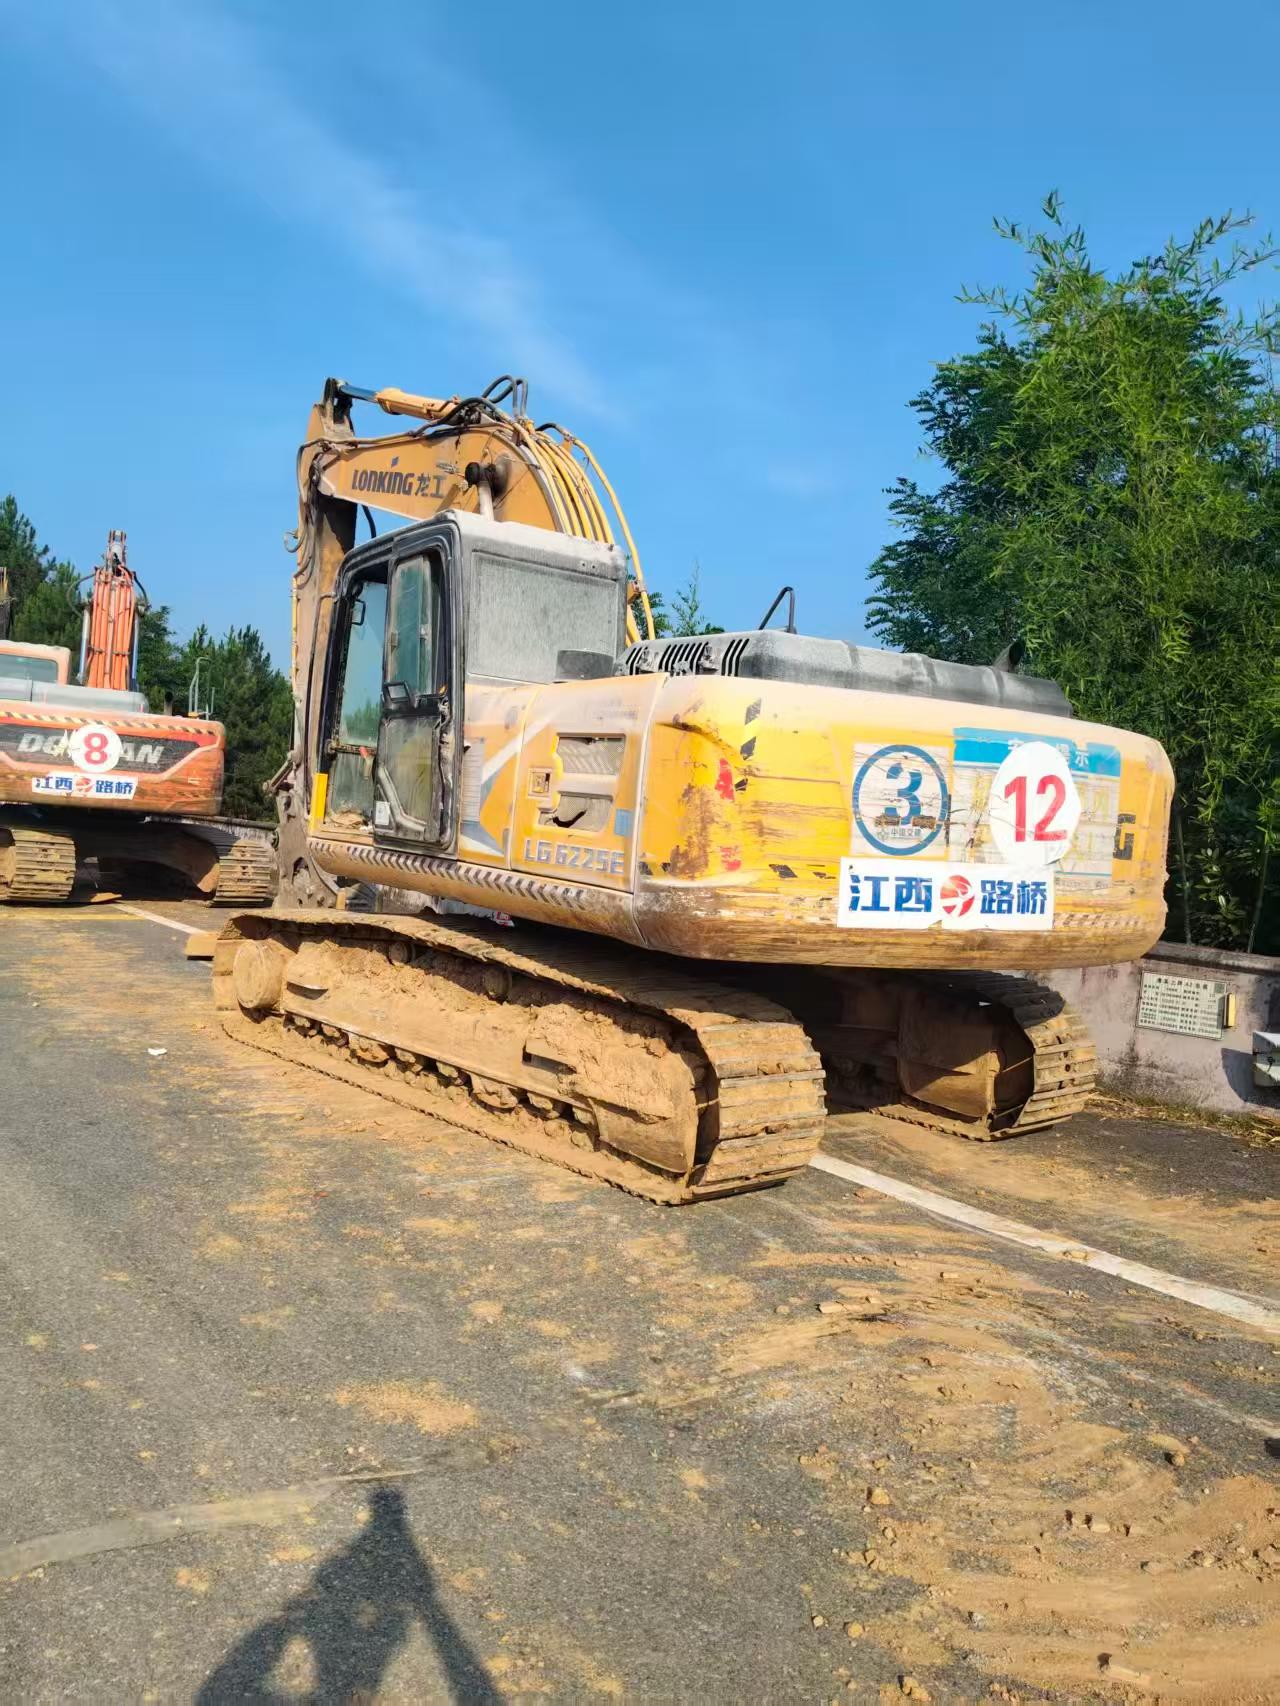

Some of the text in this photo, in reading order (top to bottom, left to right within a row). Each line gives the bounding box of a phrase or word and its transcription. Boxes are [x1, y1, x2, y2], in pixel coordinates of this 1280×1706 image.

[352, 469, 447, 498] LONKING 龙工
[16, 733, 165, 765] DOAN
[83, 732, 109, 765] 8
[35, 776, 134, 795] 江西 路桥
[884, 762, 923, 826] 3
[1004, 774, 1067, 843] 12
[848, 873, 1048, 915] 江西 路桥
